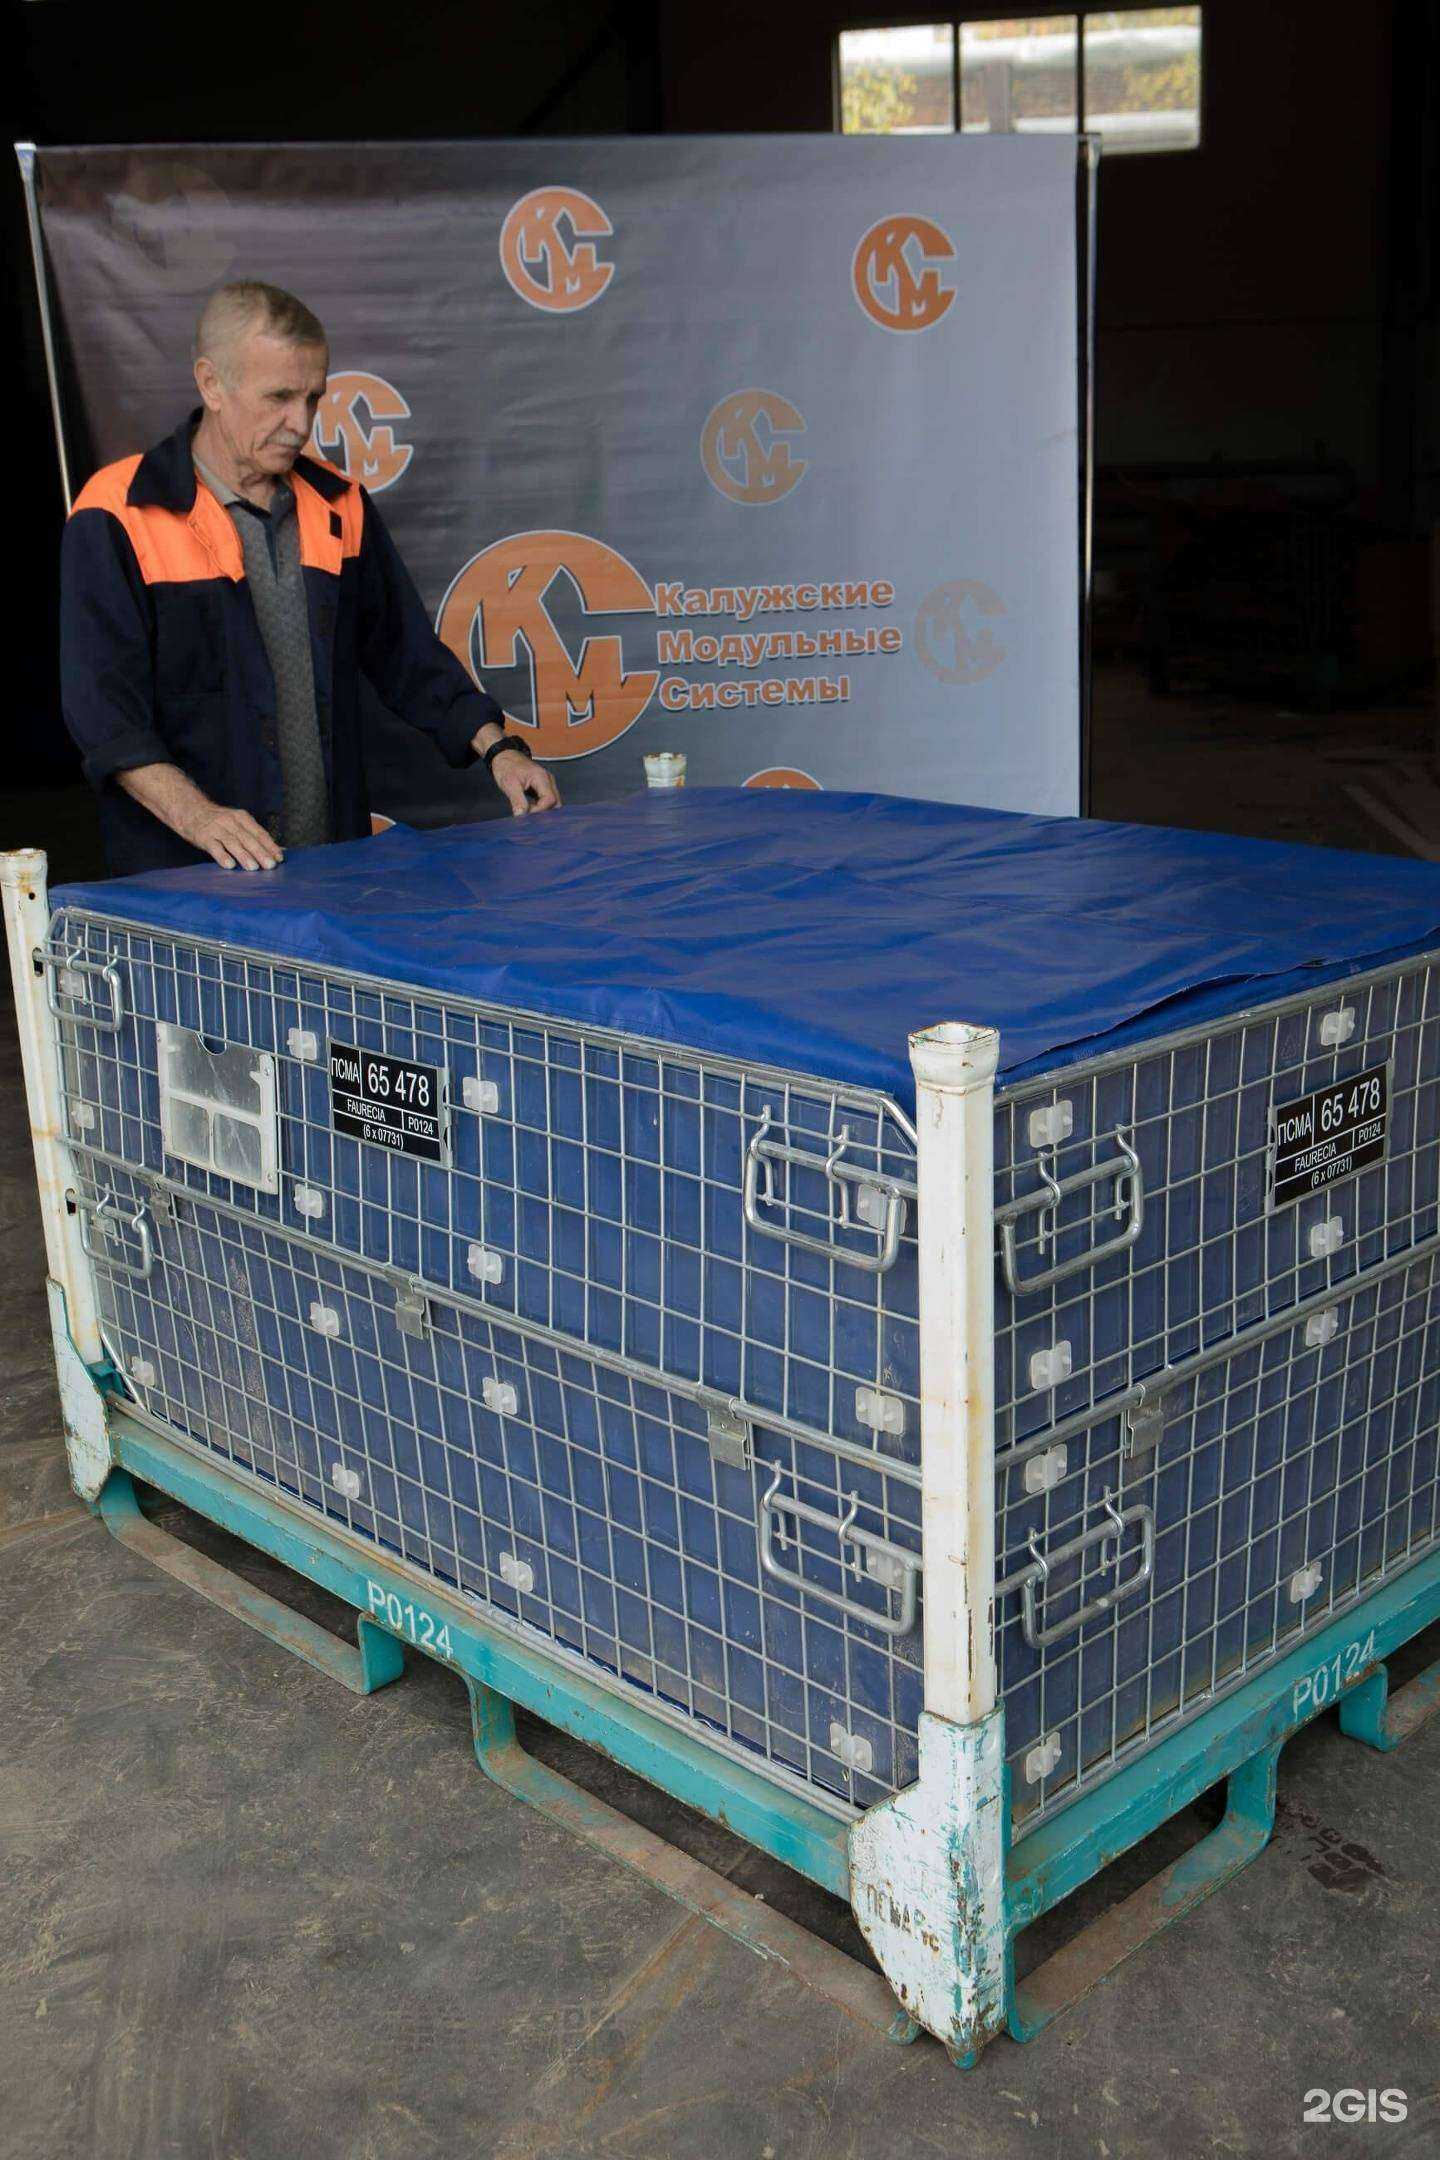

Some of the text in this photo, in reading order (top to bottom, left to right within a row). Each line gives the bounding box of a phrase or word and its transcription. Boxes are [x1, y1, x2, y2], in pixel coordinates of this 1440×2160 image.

[655, 580, 895, 621] Калужские
[657, 626, 902, 667] Модульные
[659, 674, 850, 711] Системы
[331, 1057, 430, 1108] ПСМА 65 478
[347, 1099, 386, 1122] FAURECIA
[408, 1116, 434, 1135] P0124
[1277, 1077, 1380, 1146] ПСМА 65 478
[1358, 1121, 1382, 1143] P0124
[1294, 1142, 1337, 1173] FAURECIA
[367, 1579, 454, 1660] P0124
[1293, 1630, 1375, 1723] P0124
